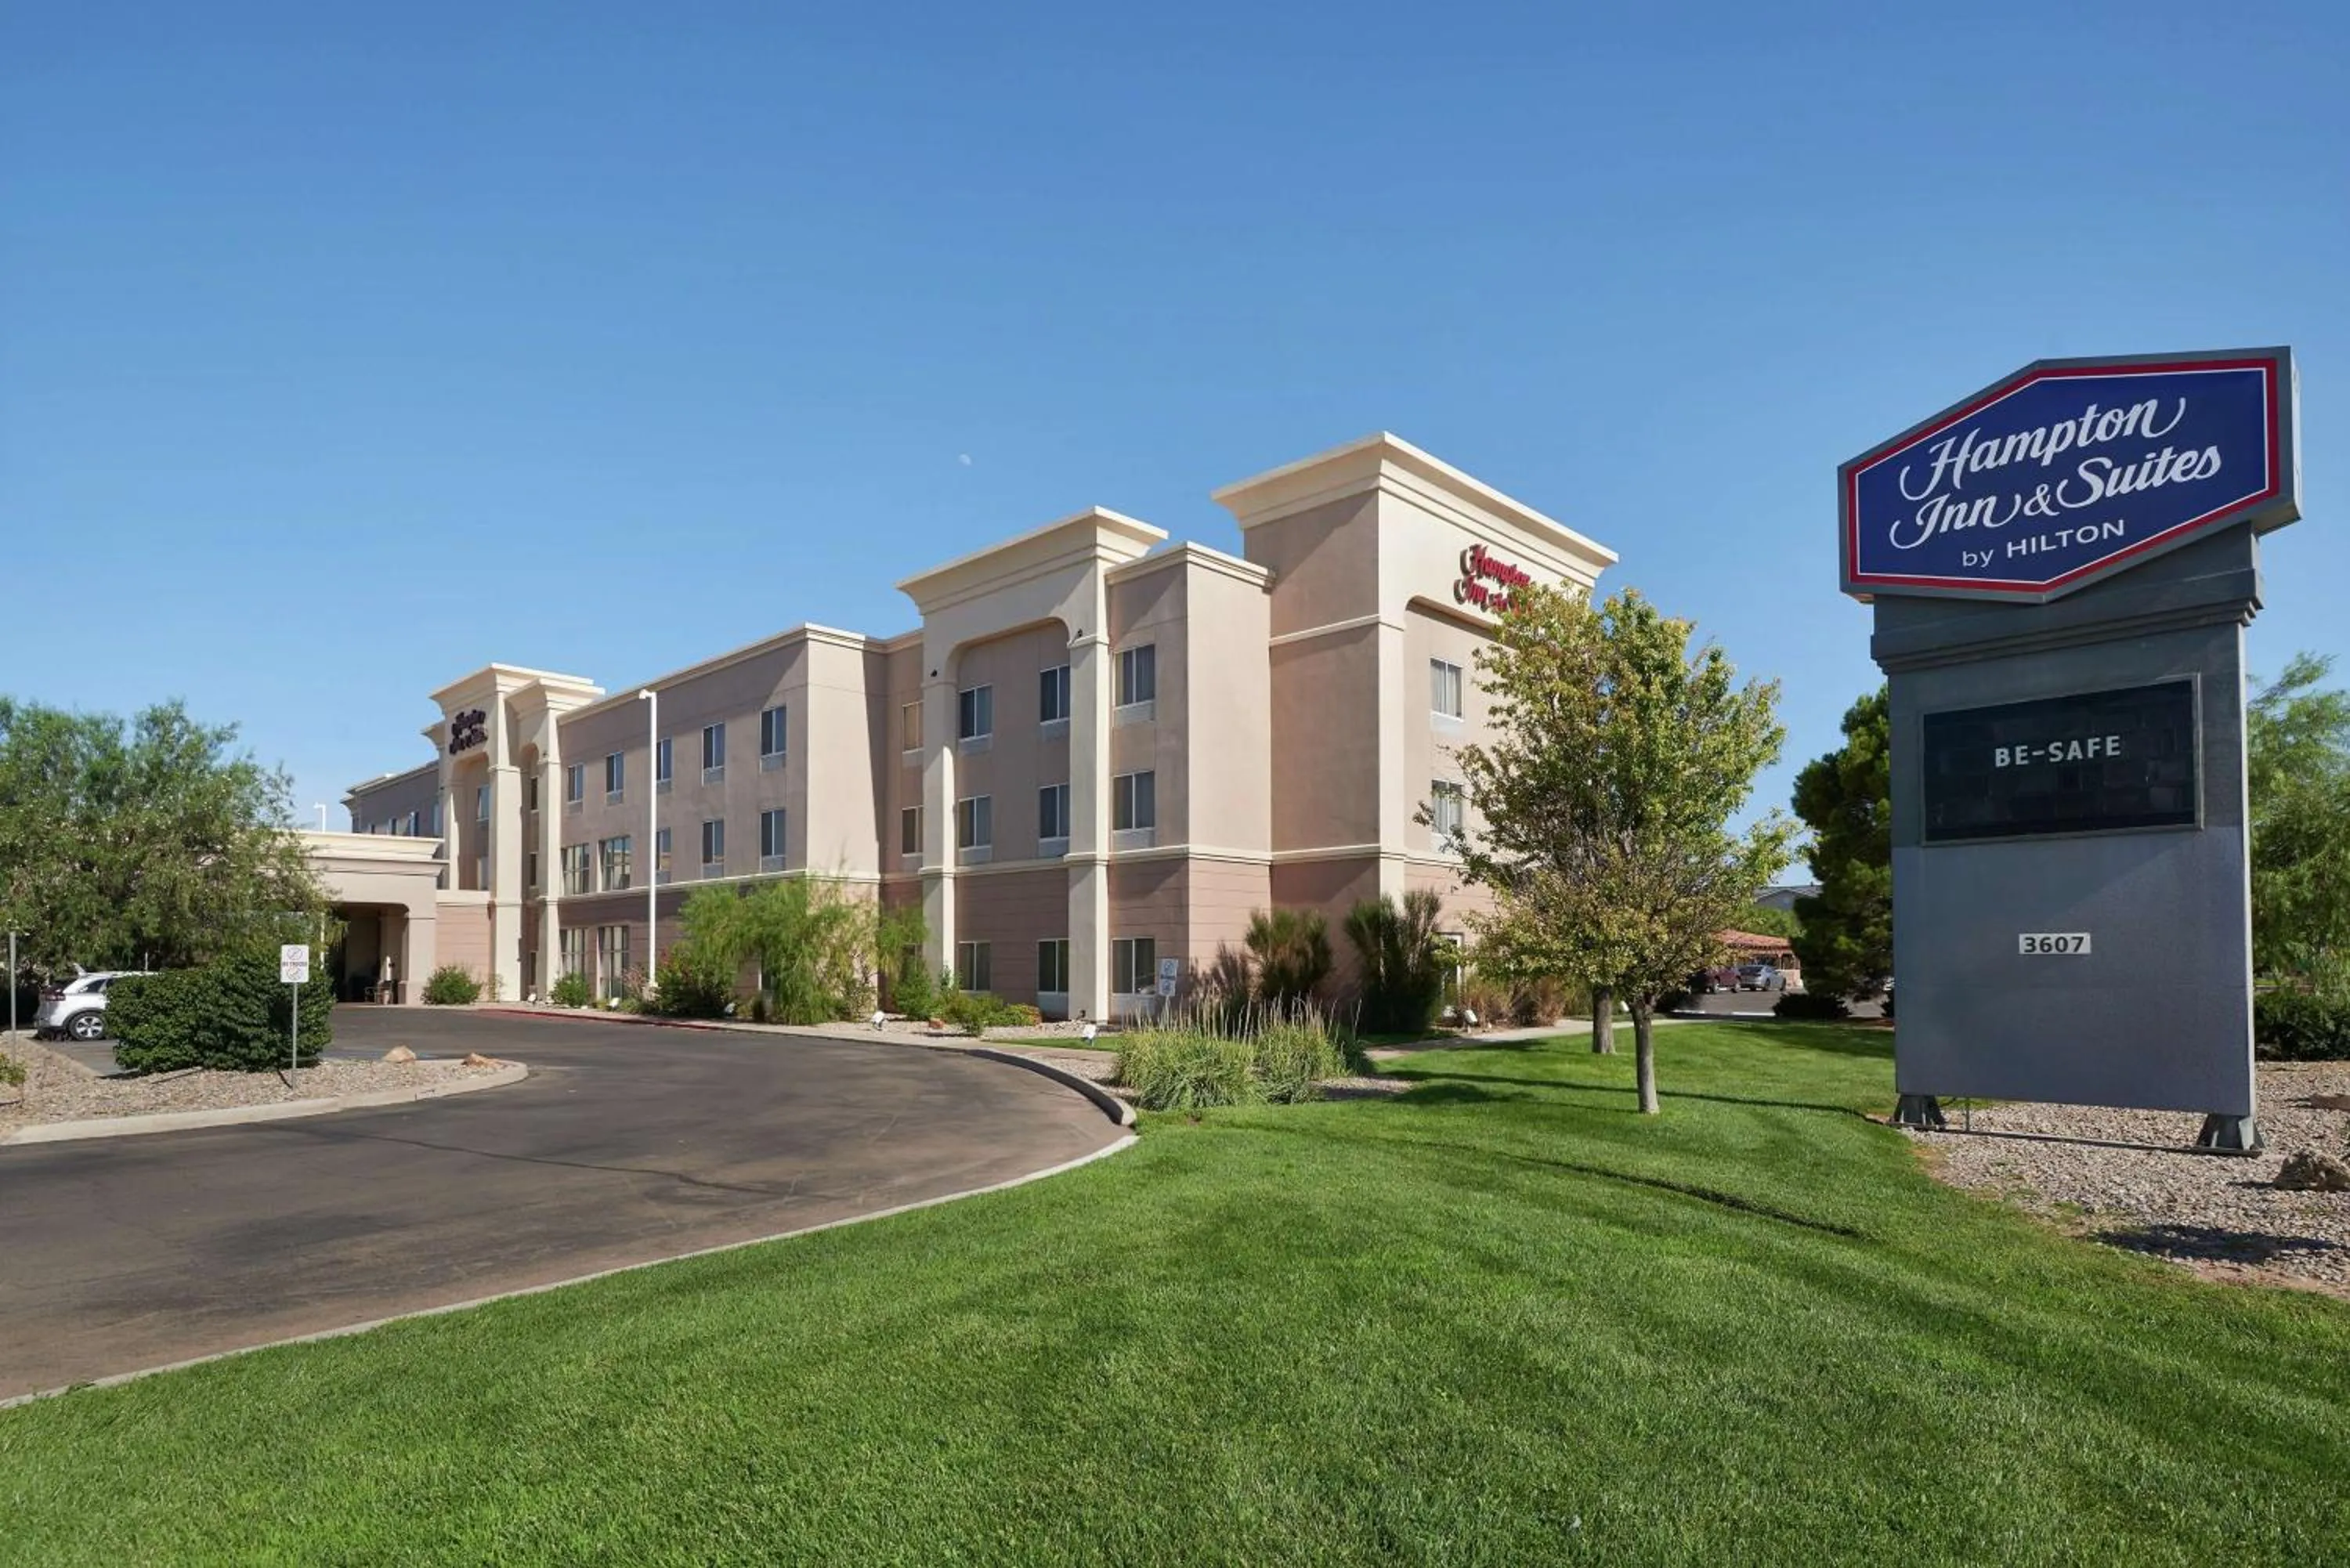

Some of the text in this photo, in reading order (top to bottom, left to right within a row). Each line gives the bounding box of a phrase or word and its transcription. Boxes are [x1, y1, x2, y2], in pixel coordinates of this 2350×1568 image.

[1900, 397, 2186, 500] Hampton
[1889, 446, 2222, 549] Inn & Suites
[1962, 520, 2124, 569] by HILTON
[1995, 735, 2120, 768] BE-SAFE
[2023, 936, 2084, 953] 3607
